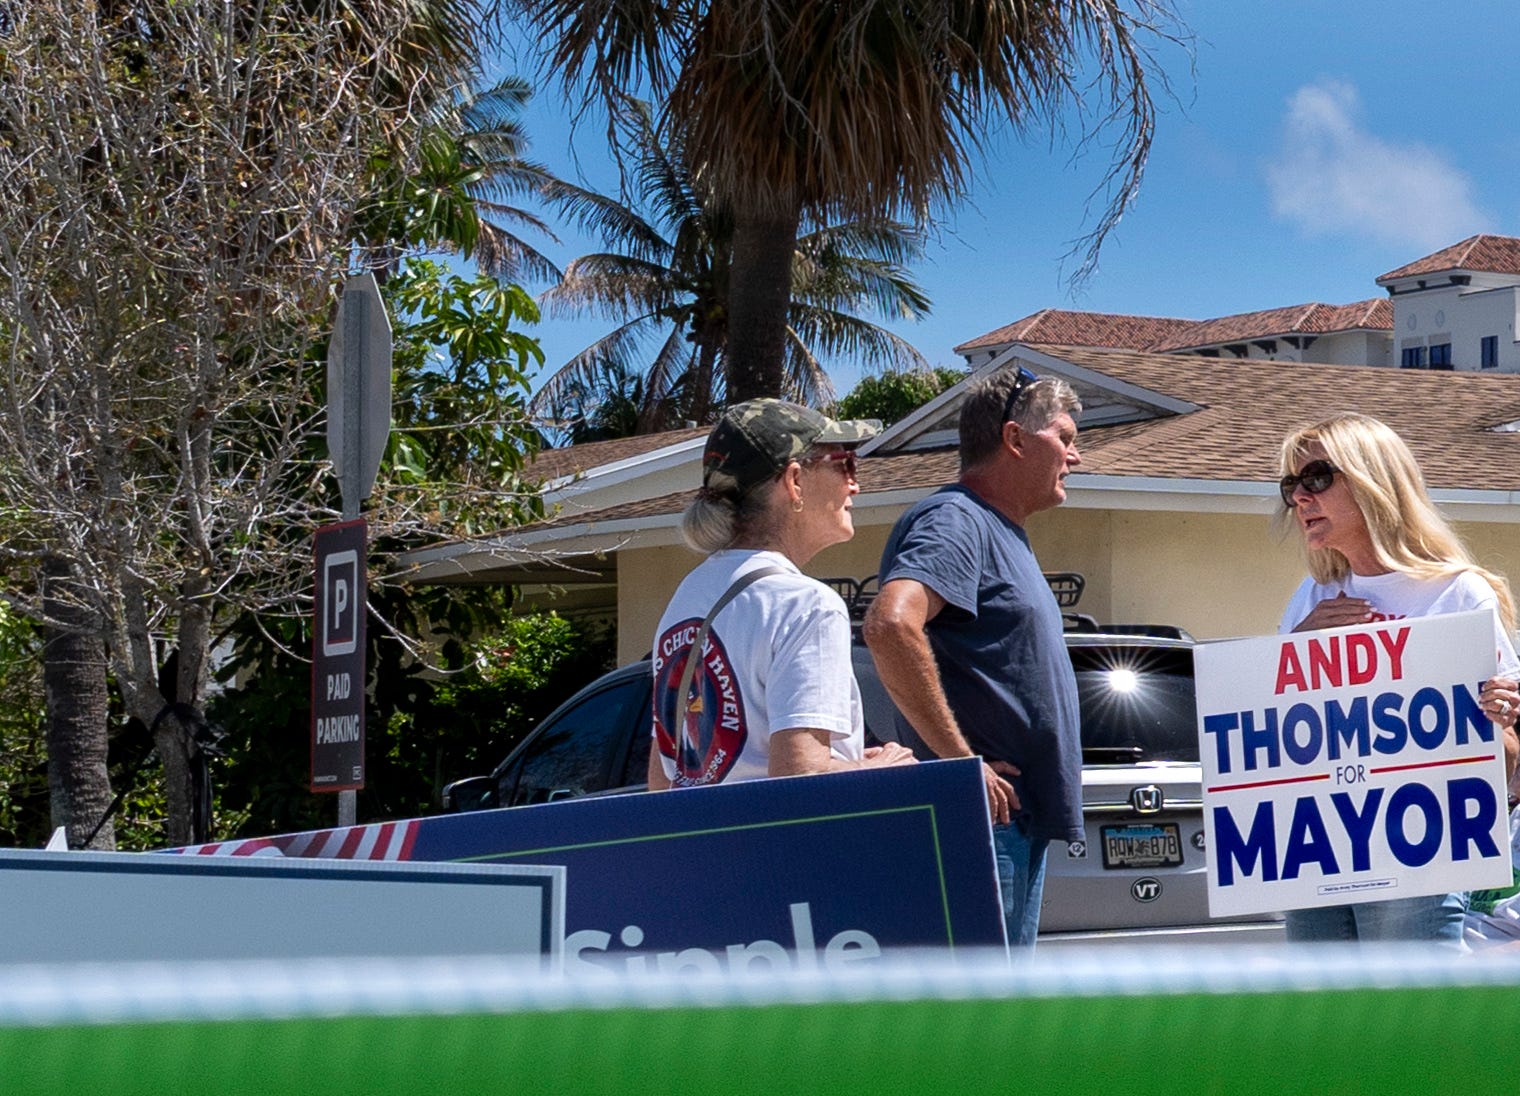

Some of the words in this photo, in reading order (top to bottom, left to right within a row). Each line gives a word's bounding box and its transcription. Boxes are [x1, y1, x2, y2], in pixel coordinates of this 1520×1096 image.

[334, 579, 348, 630] P
[327, 672, 351, 701] PAID
[663, 626, 714, 658] CHICN
[708, 655, 740, 732] HAVEN
[1274, 626, 1411, 696] ANDY
[317, 714, 360, 745] PARKING
[1204, 680, 1495, 775] THOMSON
[1336, 764, 1366, 786] FOR
[1211, 777, 1500, 887] MAYOR
[1136, 884, 1158, 898] VT
